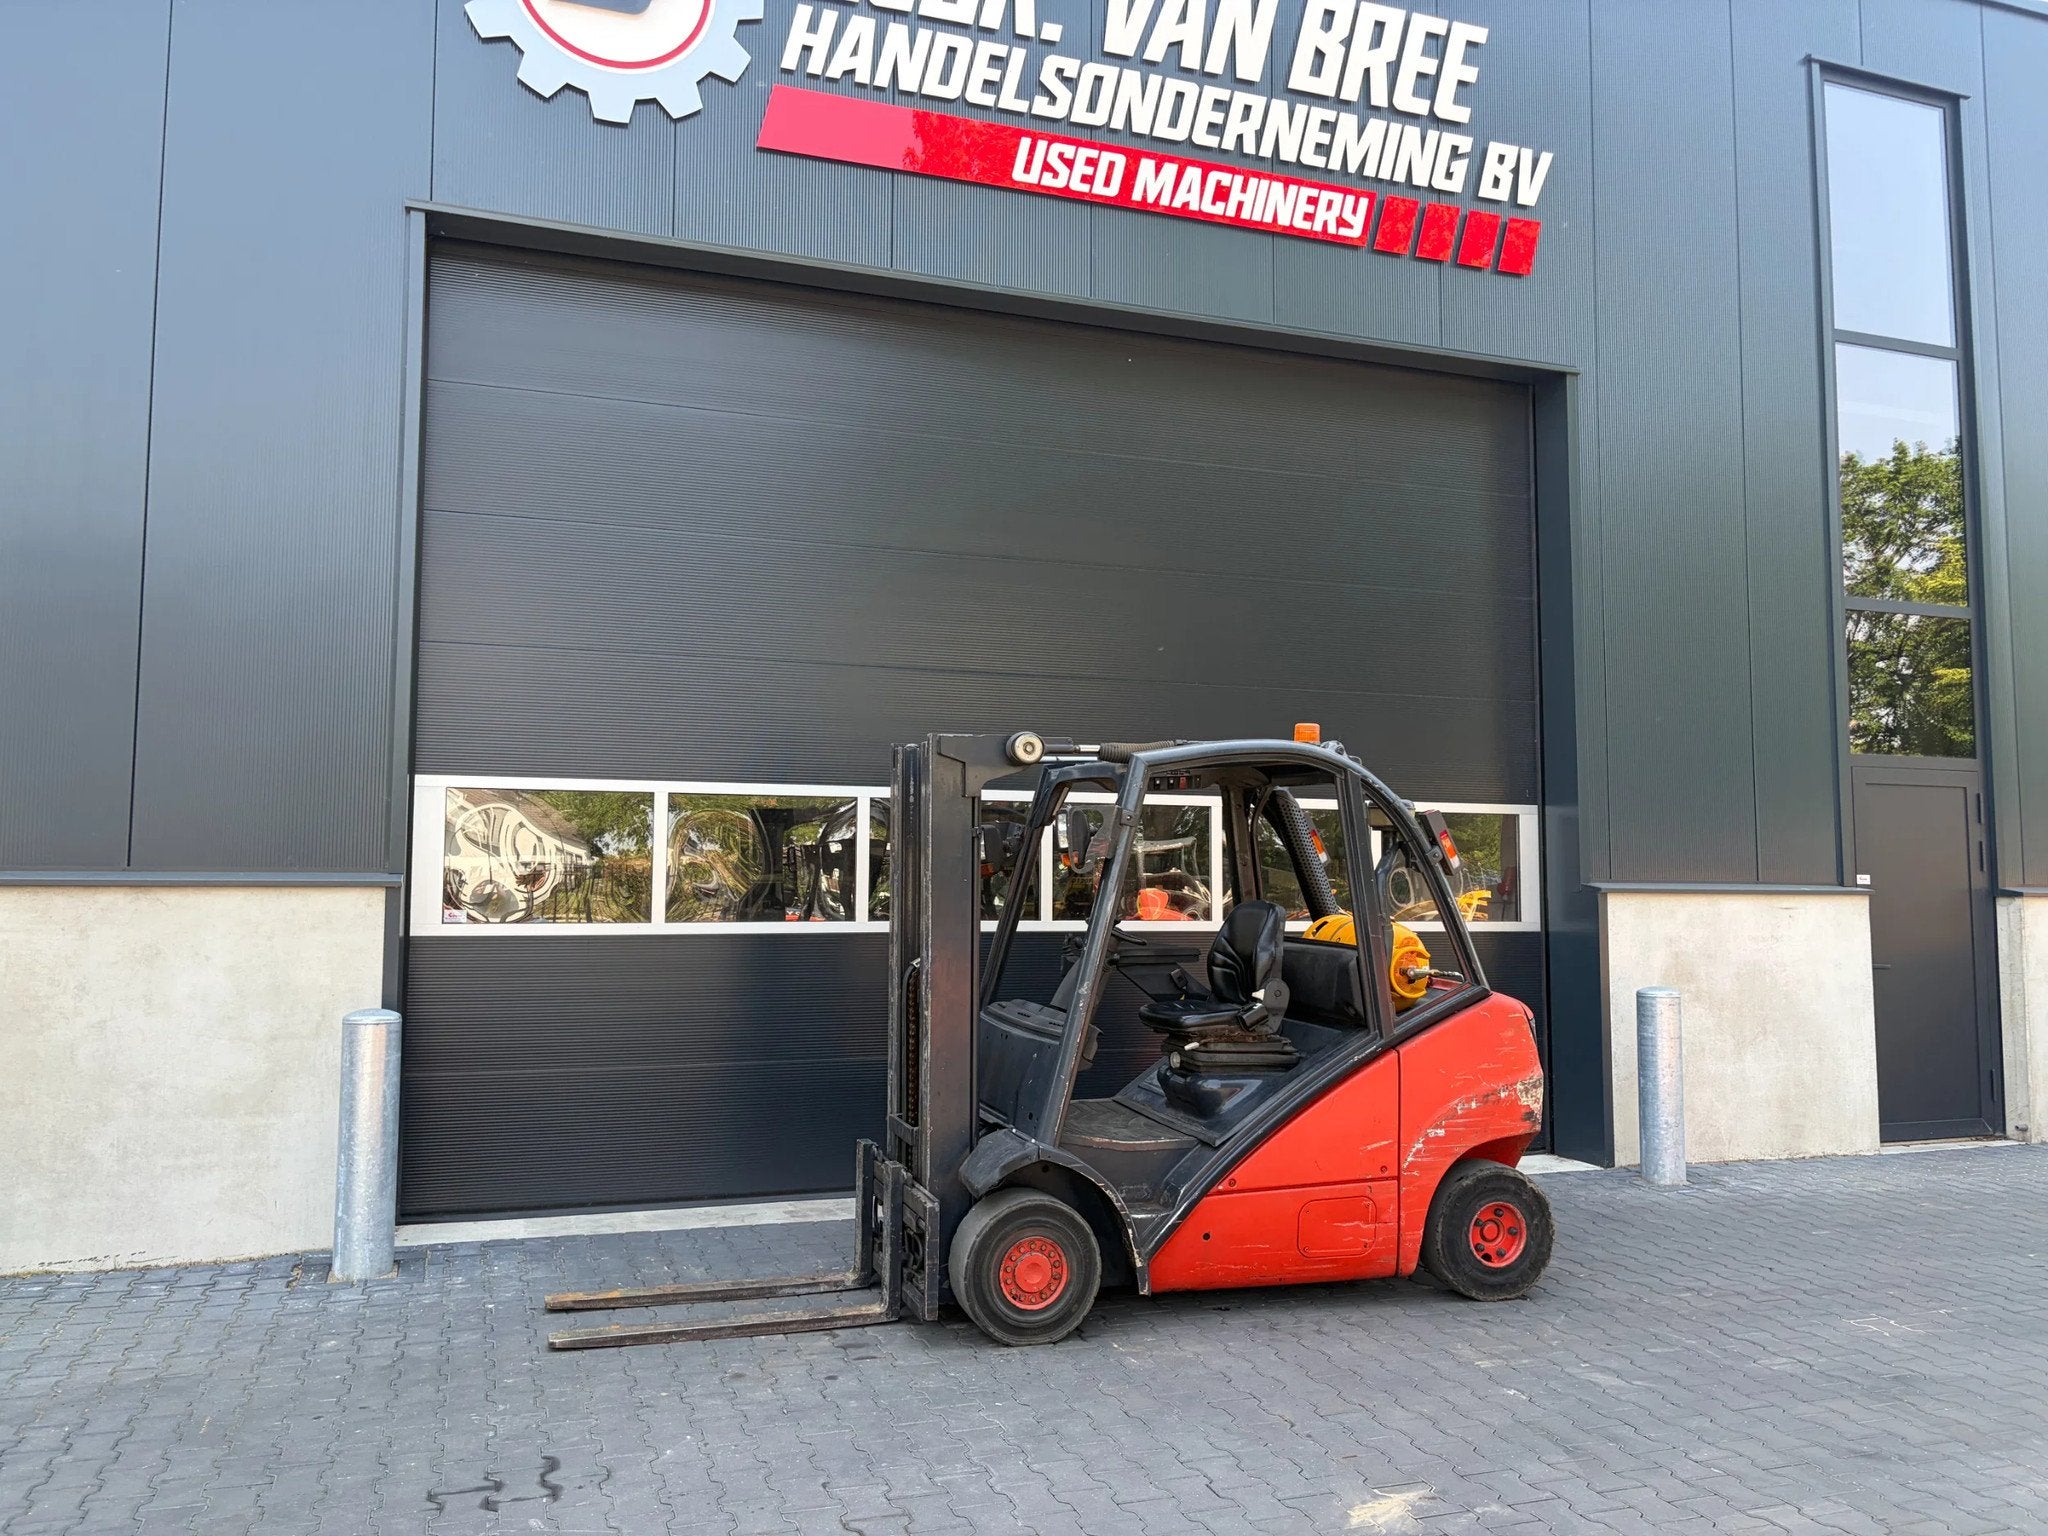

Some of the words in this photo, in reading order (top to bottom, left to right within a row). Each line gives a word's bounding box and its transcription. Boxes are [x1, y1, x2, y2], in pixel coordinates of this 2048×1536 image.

[780, 3, 1474, 194] HANDELSONDERNEMING
[1477, 141, 1554, 206] BV
[1103, 0, 1275, 82] VAN
[1287, 1, 1489, 124] BREE
[1011, 137, 1125, 197] USED
[1131, 158, 1369, 237] MACHINERY
